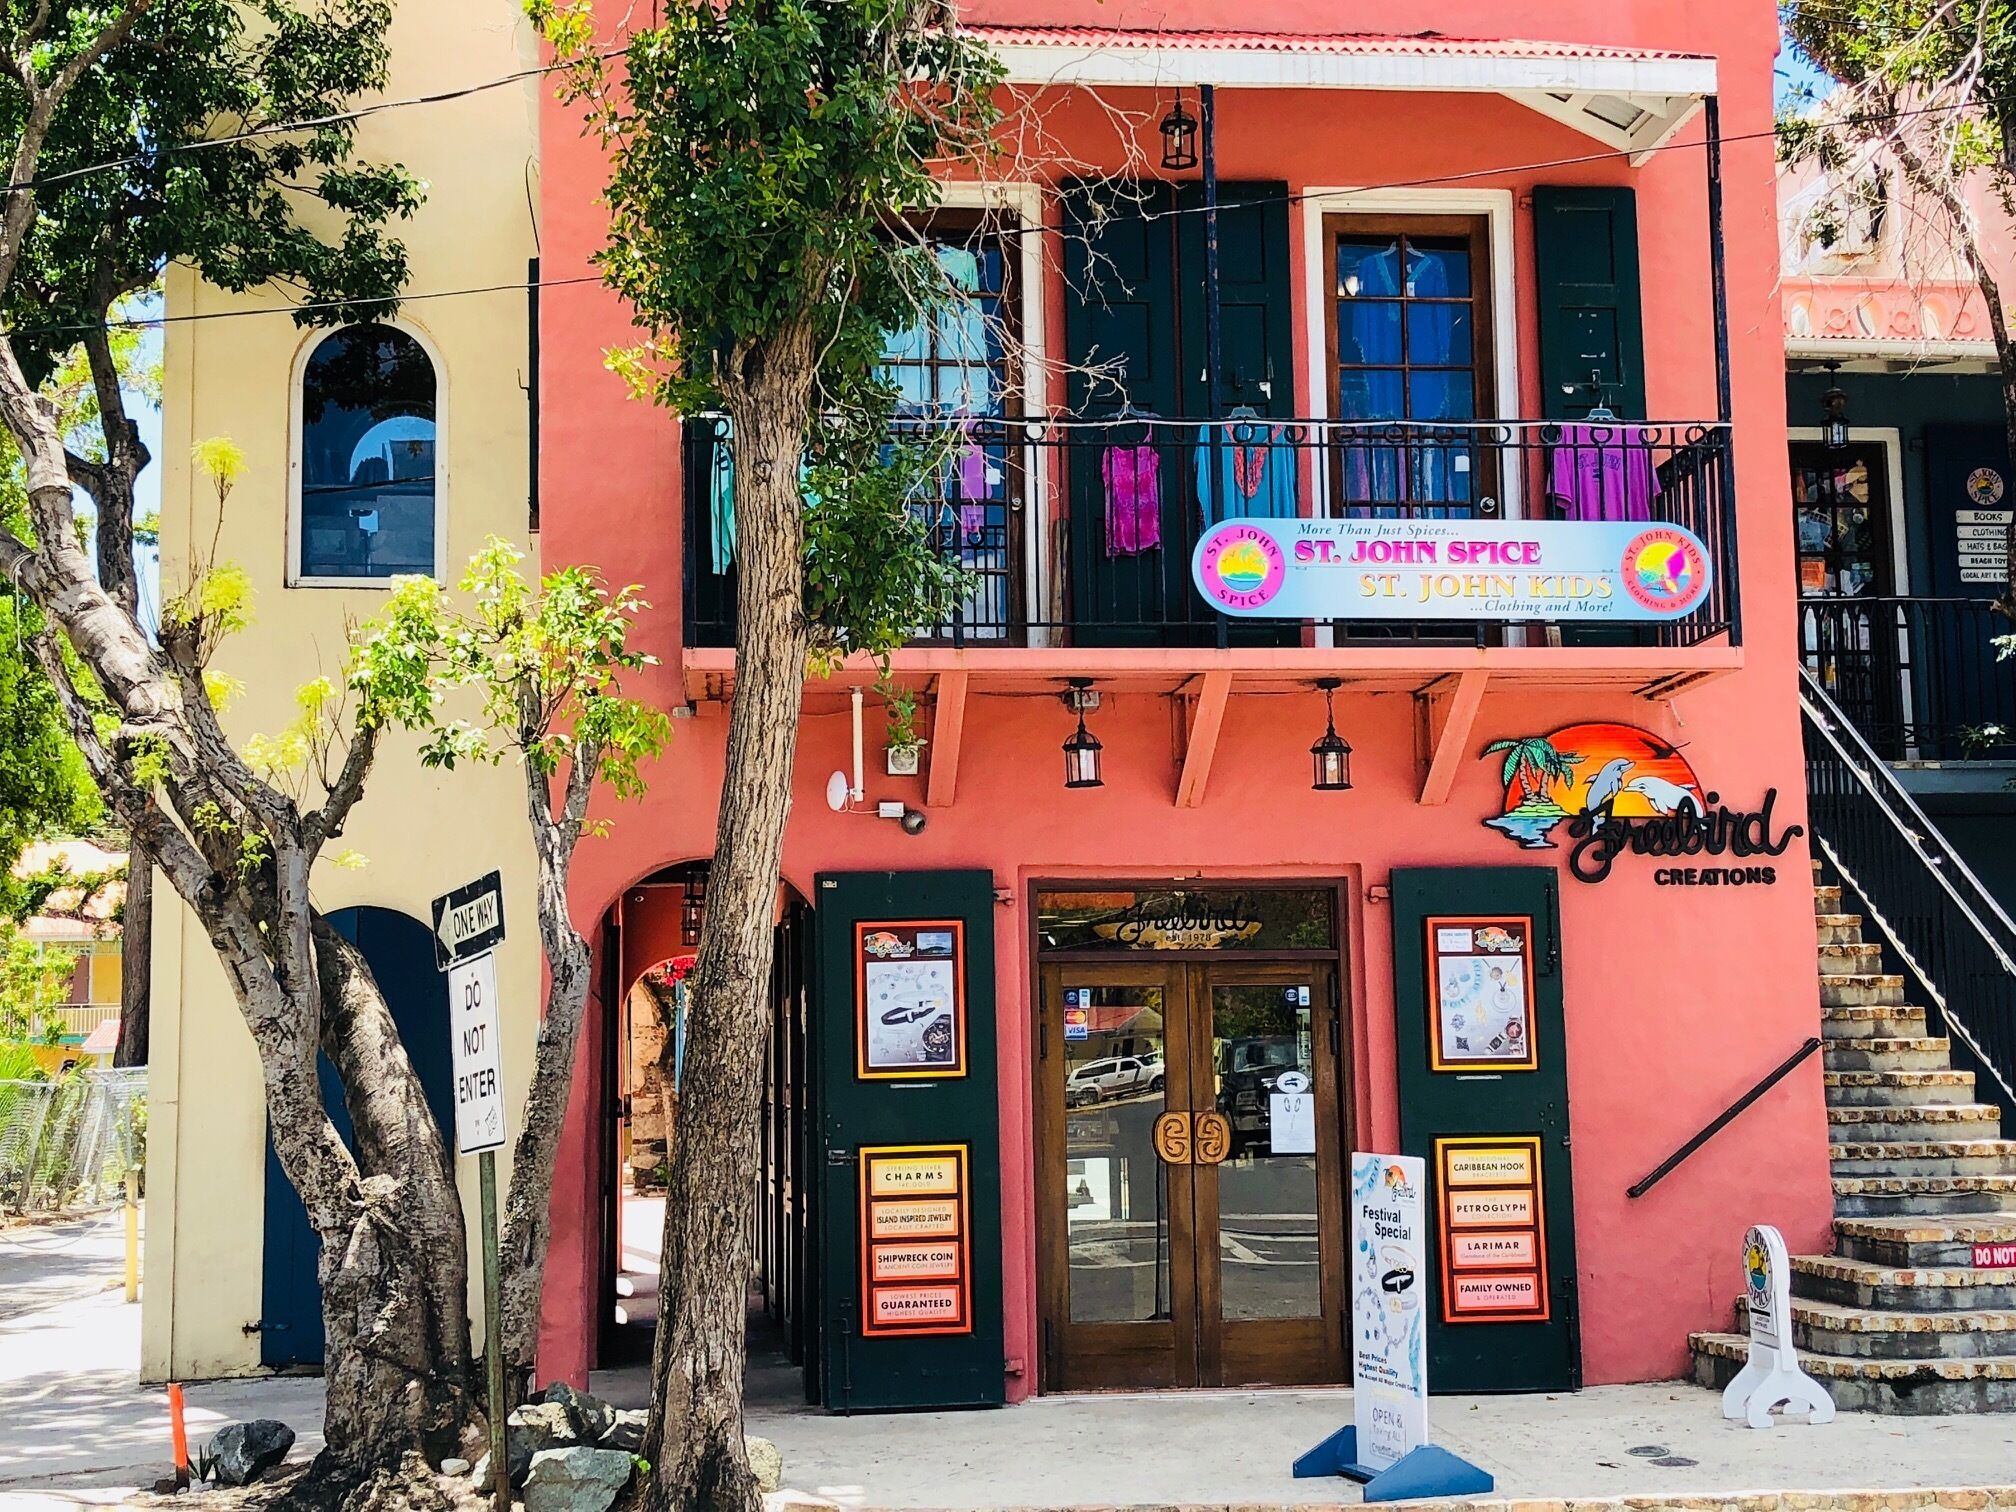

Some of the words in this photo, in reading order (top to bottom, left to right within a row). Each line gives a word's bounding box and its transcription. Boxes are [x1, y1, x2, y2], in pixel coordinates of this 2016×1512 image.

[1980, 469, 2000, 484] JOHN
[1971, 491, 2000, 504] SPICE
[1973, 512, 2003, 521] BOOKS
[1297, 523, 1332, 535] More
[1338, 523, 1371, 535] Than
[1375, 524, 1402, 538] Just
[1406, 524, 1459, 539] Spices...
[1206, 536, 1229, 557] ST.
[1236, 529, 1279, 557] JOHN
[1640, 531, 1673, 546] JOHN
[1678, 536, 1700, 564] KIDS
[1967, 542, 1985, 550] HATS
[1294, 539, 1341, 564] ST.
[1347, 540, 1437, 565] JOHN
[1447, 541, 1543, 565] SPICE
[1359, 573, 1407, 597] ST.
[1418, 574, 1516, 603] JOHN
[1528, 575, 1613, 599] KIDS
[1628, 581, 1665, 608] CLOTHING
[1679, 584, 1698, 605] MORE
[1217, 589, 1269, 606] SPICE
[1470, 600, 1541, 615] ...Clothing
[1545, 601, 1571, 612] and
[1575, 601, 1613, 612] More!
[1569, 788, 1804, 883] Freebird
[1654, 867, 1776, 886] CREATIONS
[454, 908, 475, 938] ONE
[476, 895, 495, 927] WAY
[465, 980, 481, 1011] DO
[1068, 1026, 1085, 1034] VISA
[463, 1024, 486, 1058] NOT
[459, 1067, 496, 1104] ENTER
[1453, 1163, 1498, 1171] CARIBBEAN
[1500, 1163, 1525, 1171] HOOK
[885, 1172, 943, 1181] CHARMS
[1363, 1205, 1401, 1223] Festival
[1456, 1204, 1526, 1212] PETROGLYPH
[877, 1215, 898, 1223] ISLAND
[927, 1214, 952, 1222] JEWELRY
[1374, 1222, 1411, 1240] Special
[1468, 1241, 1519, 1250] LARIMAR
[1753, 1229, 1770, 1262] JOHN
[877, 1253, 928, 1263] SHIPWRECK
[930, 1253, 953, 1261] COIN
[1975, 1248, 1991, 1265] DO
[1993, 1247, 2016, 1264] NOT
[1460, 1284, 1492, 1293] FAMILY
[1495, 1283, 1531, 1292] OWNED
[1749, 1282, 1768, 1305] SPICE
[881, 1299, 952, 1309] GUARANTEED
[1359, 1350, 1370, 1360] Best
[1371, 1353, 1387, 1364] Prices
[1359, 1361, 1378, 1371] Highest
[1379, 1365, 1398, 1378] Quality
[1372, 1407, 1395, 1426] OPEN
